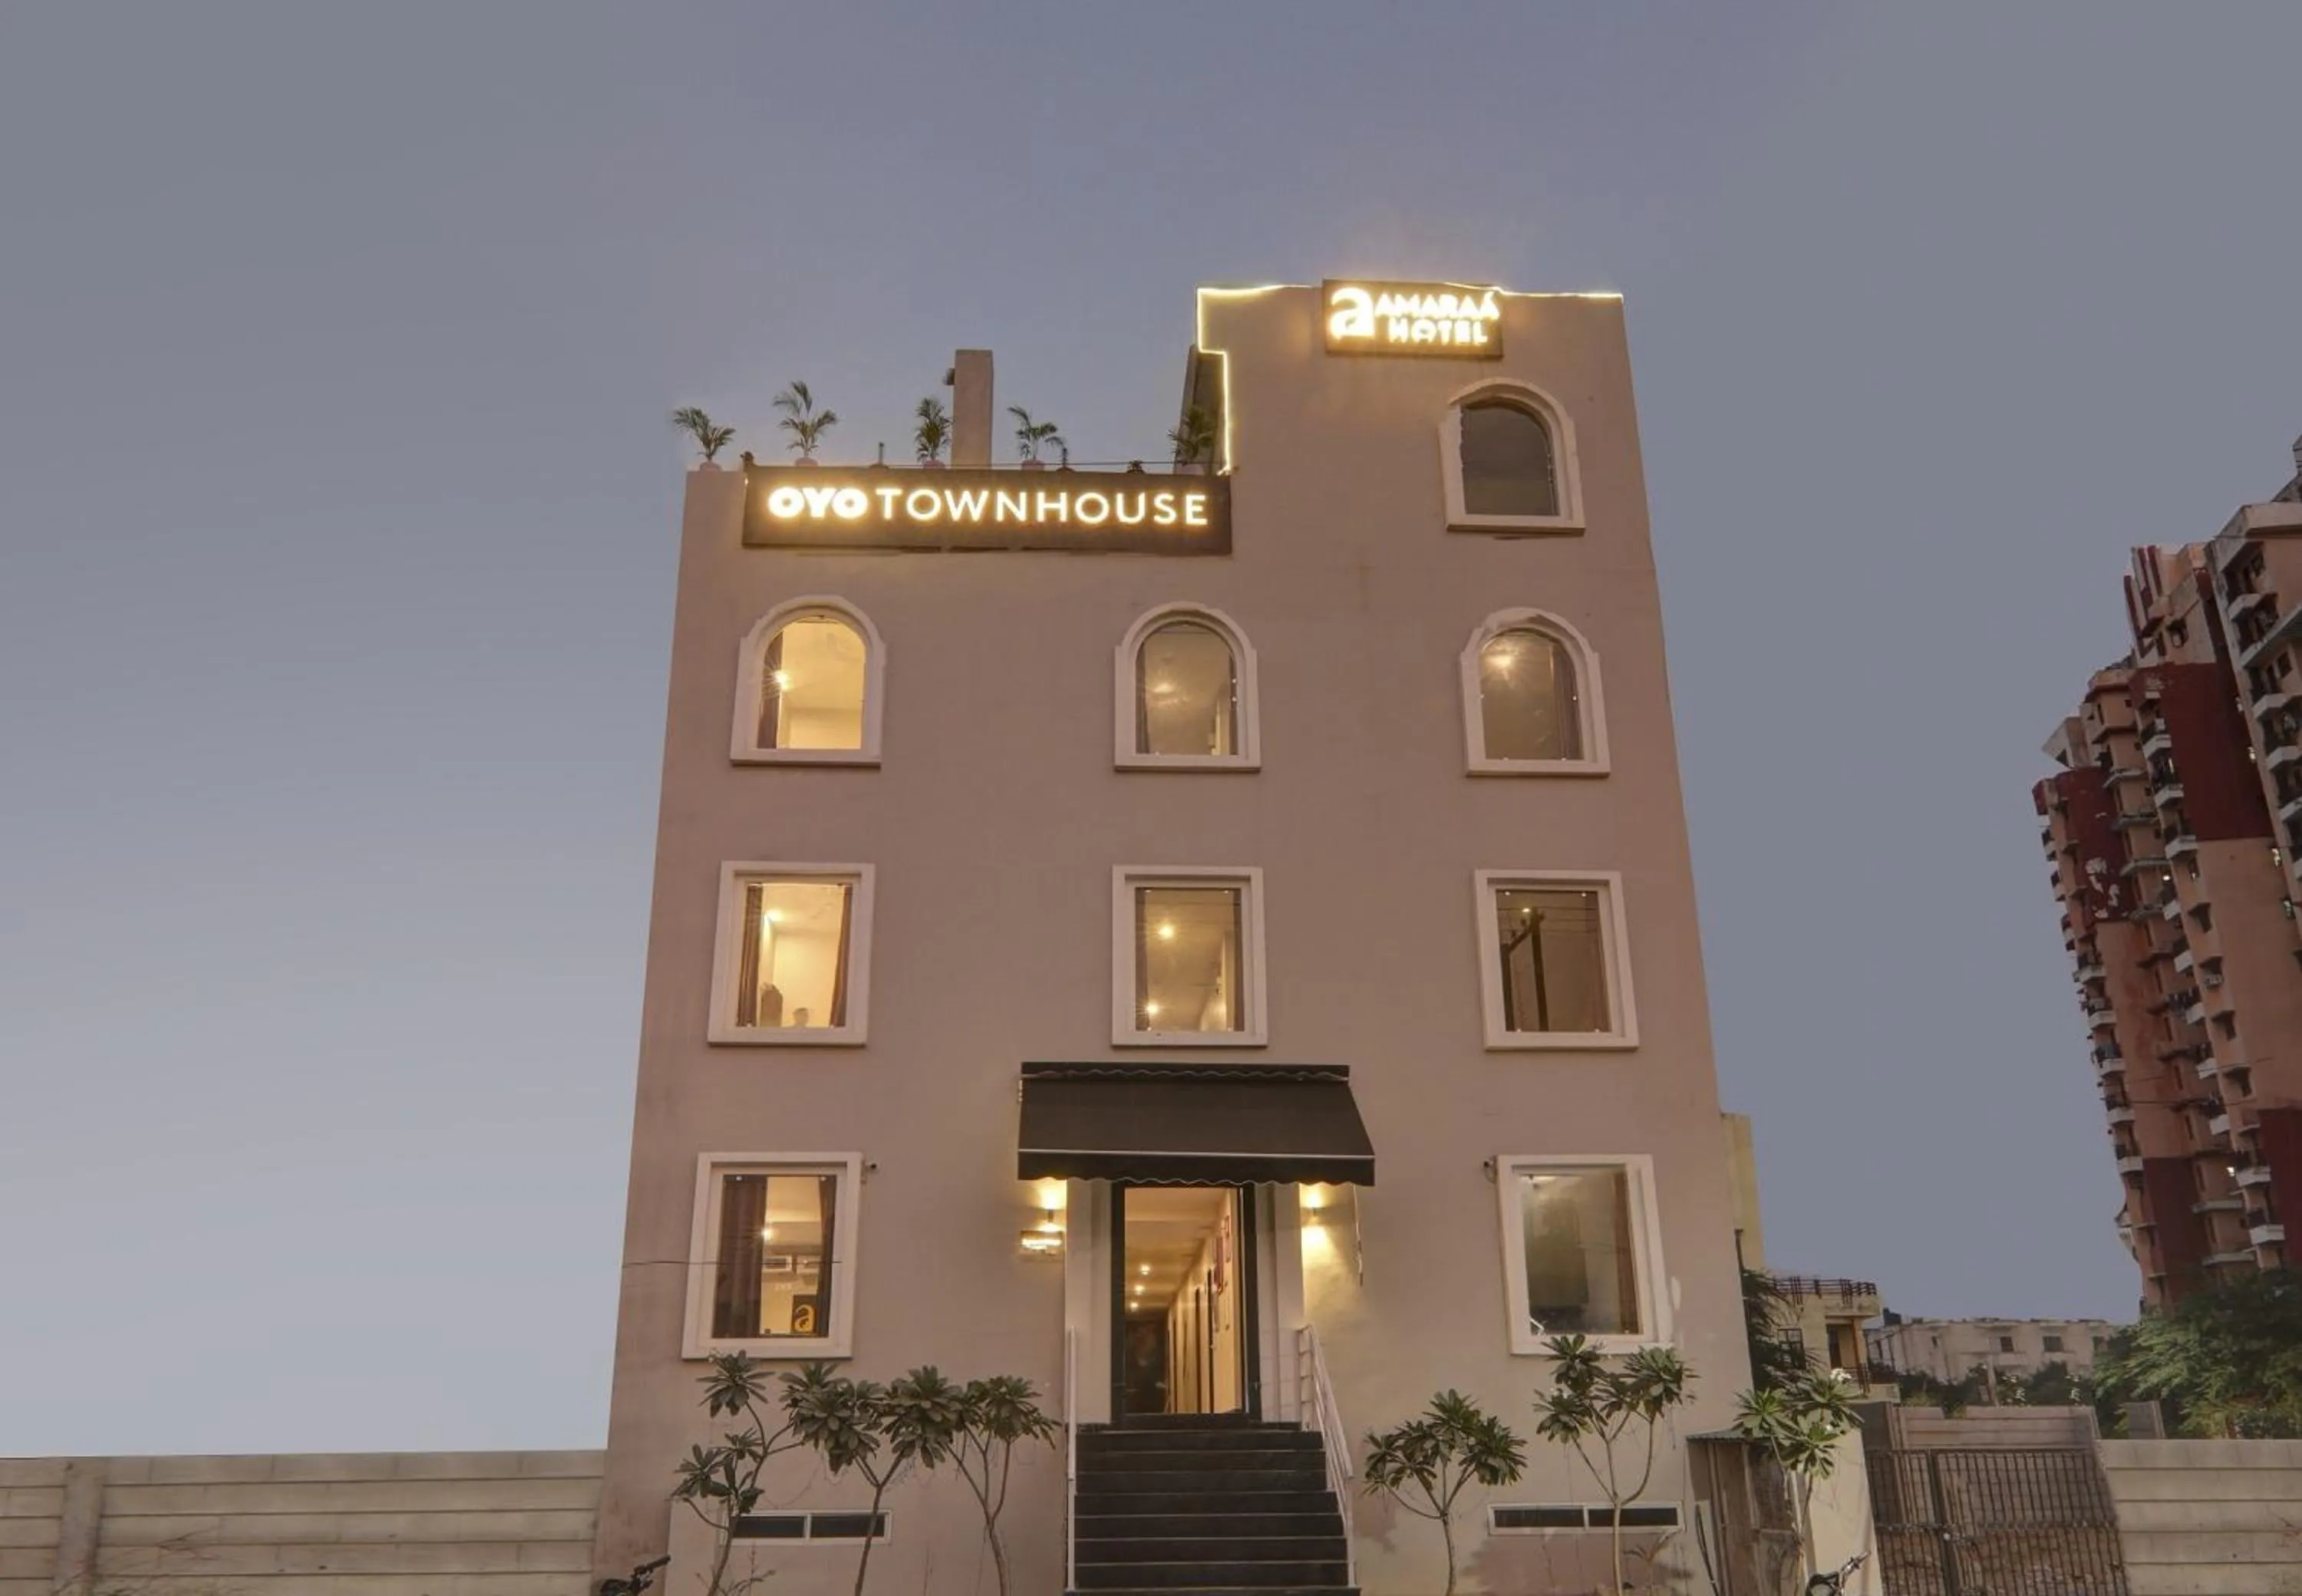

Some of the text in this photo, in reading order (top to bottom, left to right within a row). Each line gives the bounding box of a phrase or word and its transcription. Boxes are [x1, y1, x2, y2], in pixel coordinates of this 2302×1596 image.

[1329, 287, 1374, 340] a
[1387, 317, 1488, 345] HOTEL
[768, 486, 1208, 526] OYO TOWNHOUSE
[793, 1304, 814, 1332] a
